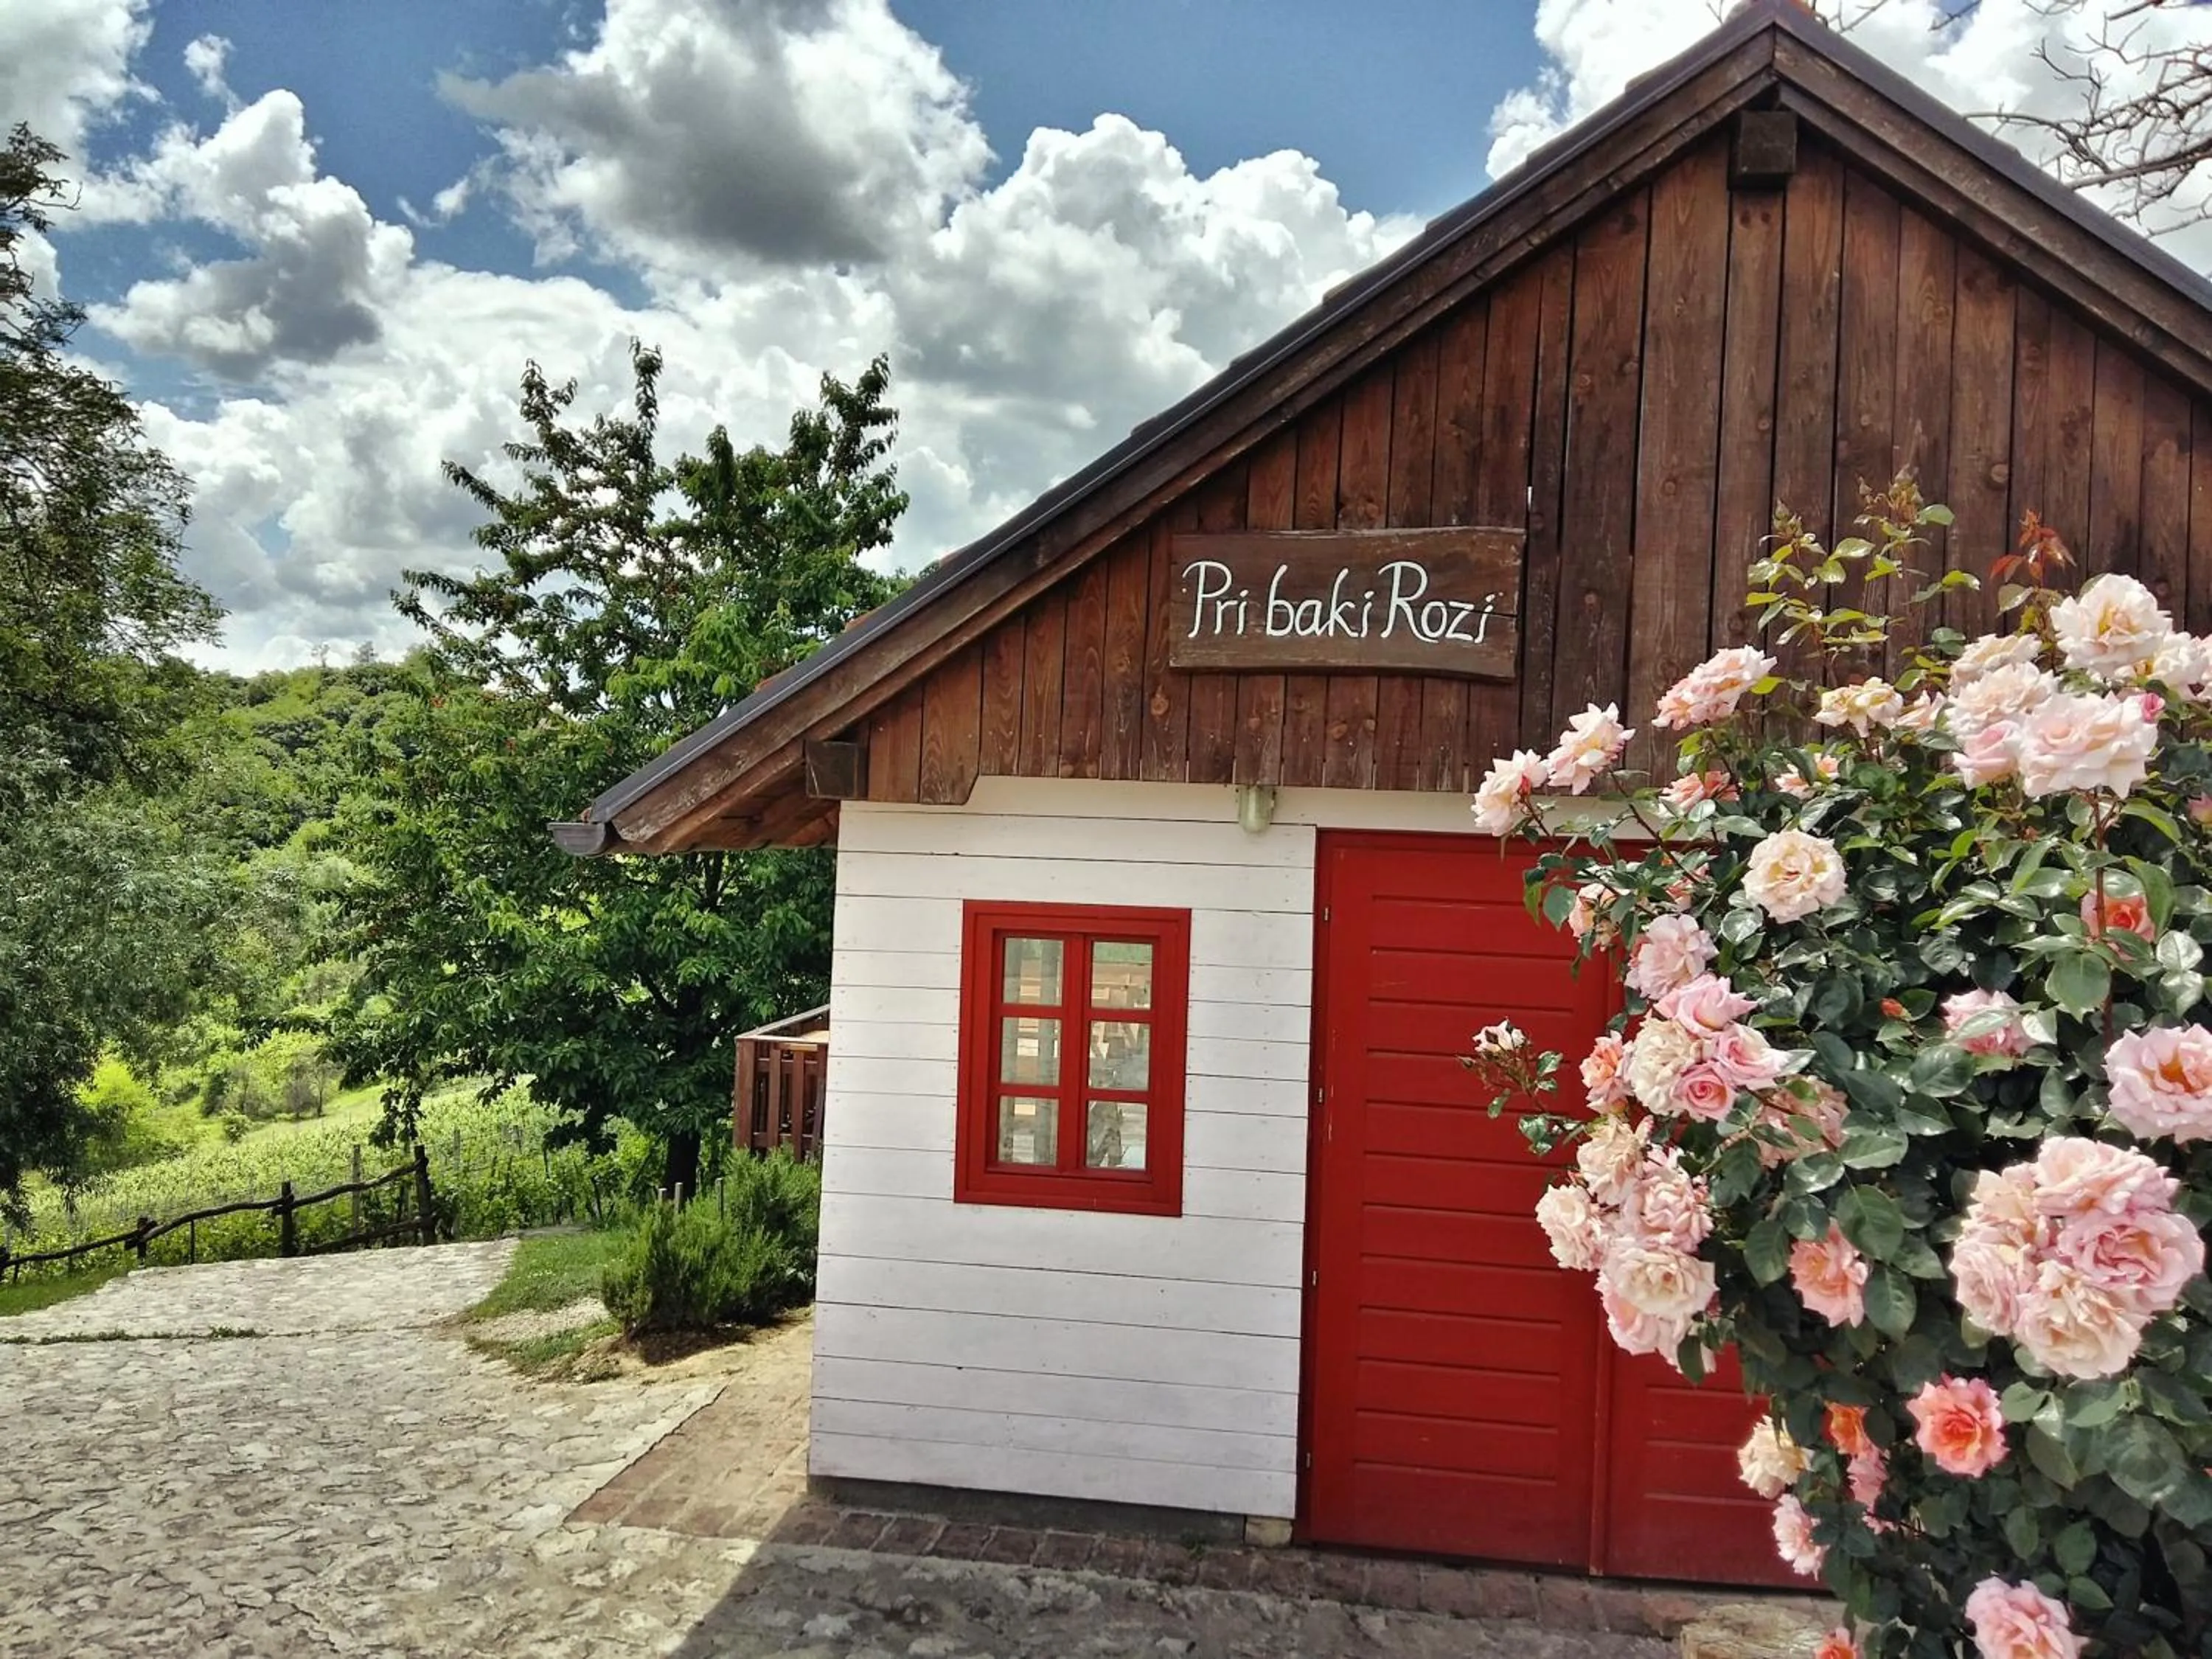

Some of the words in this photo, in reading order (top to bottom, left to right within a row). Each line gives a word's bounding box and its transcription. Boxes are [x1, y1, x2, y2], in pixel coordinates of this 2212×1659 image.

[1182, 560, 1248, 638] Pri
[1266, 564, 1374, 639] baki
[1378, 560, 1497, 644] Rozi
